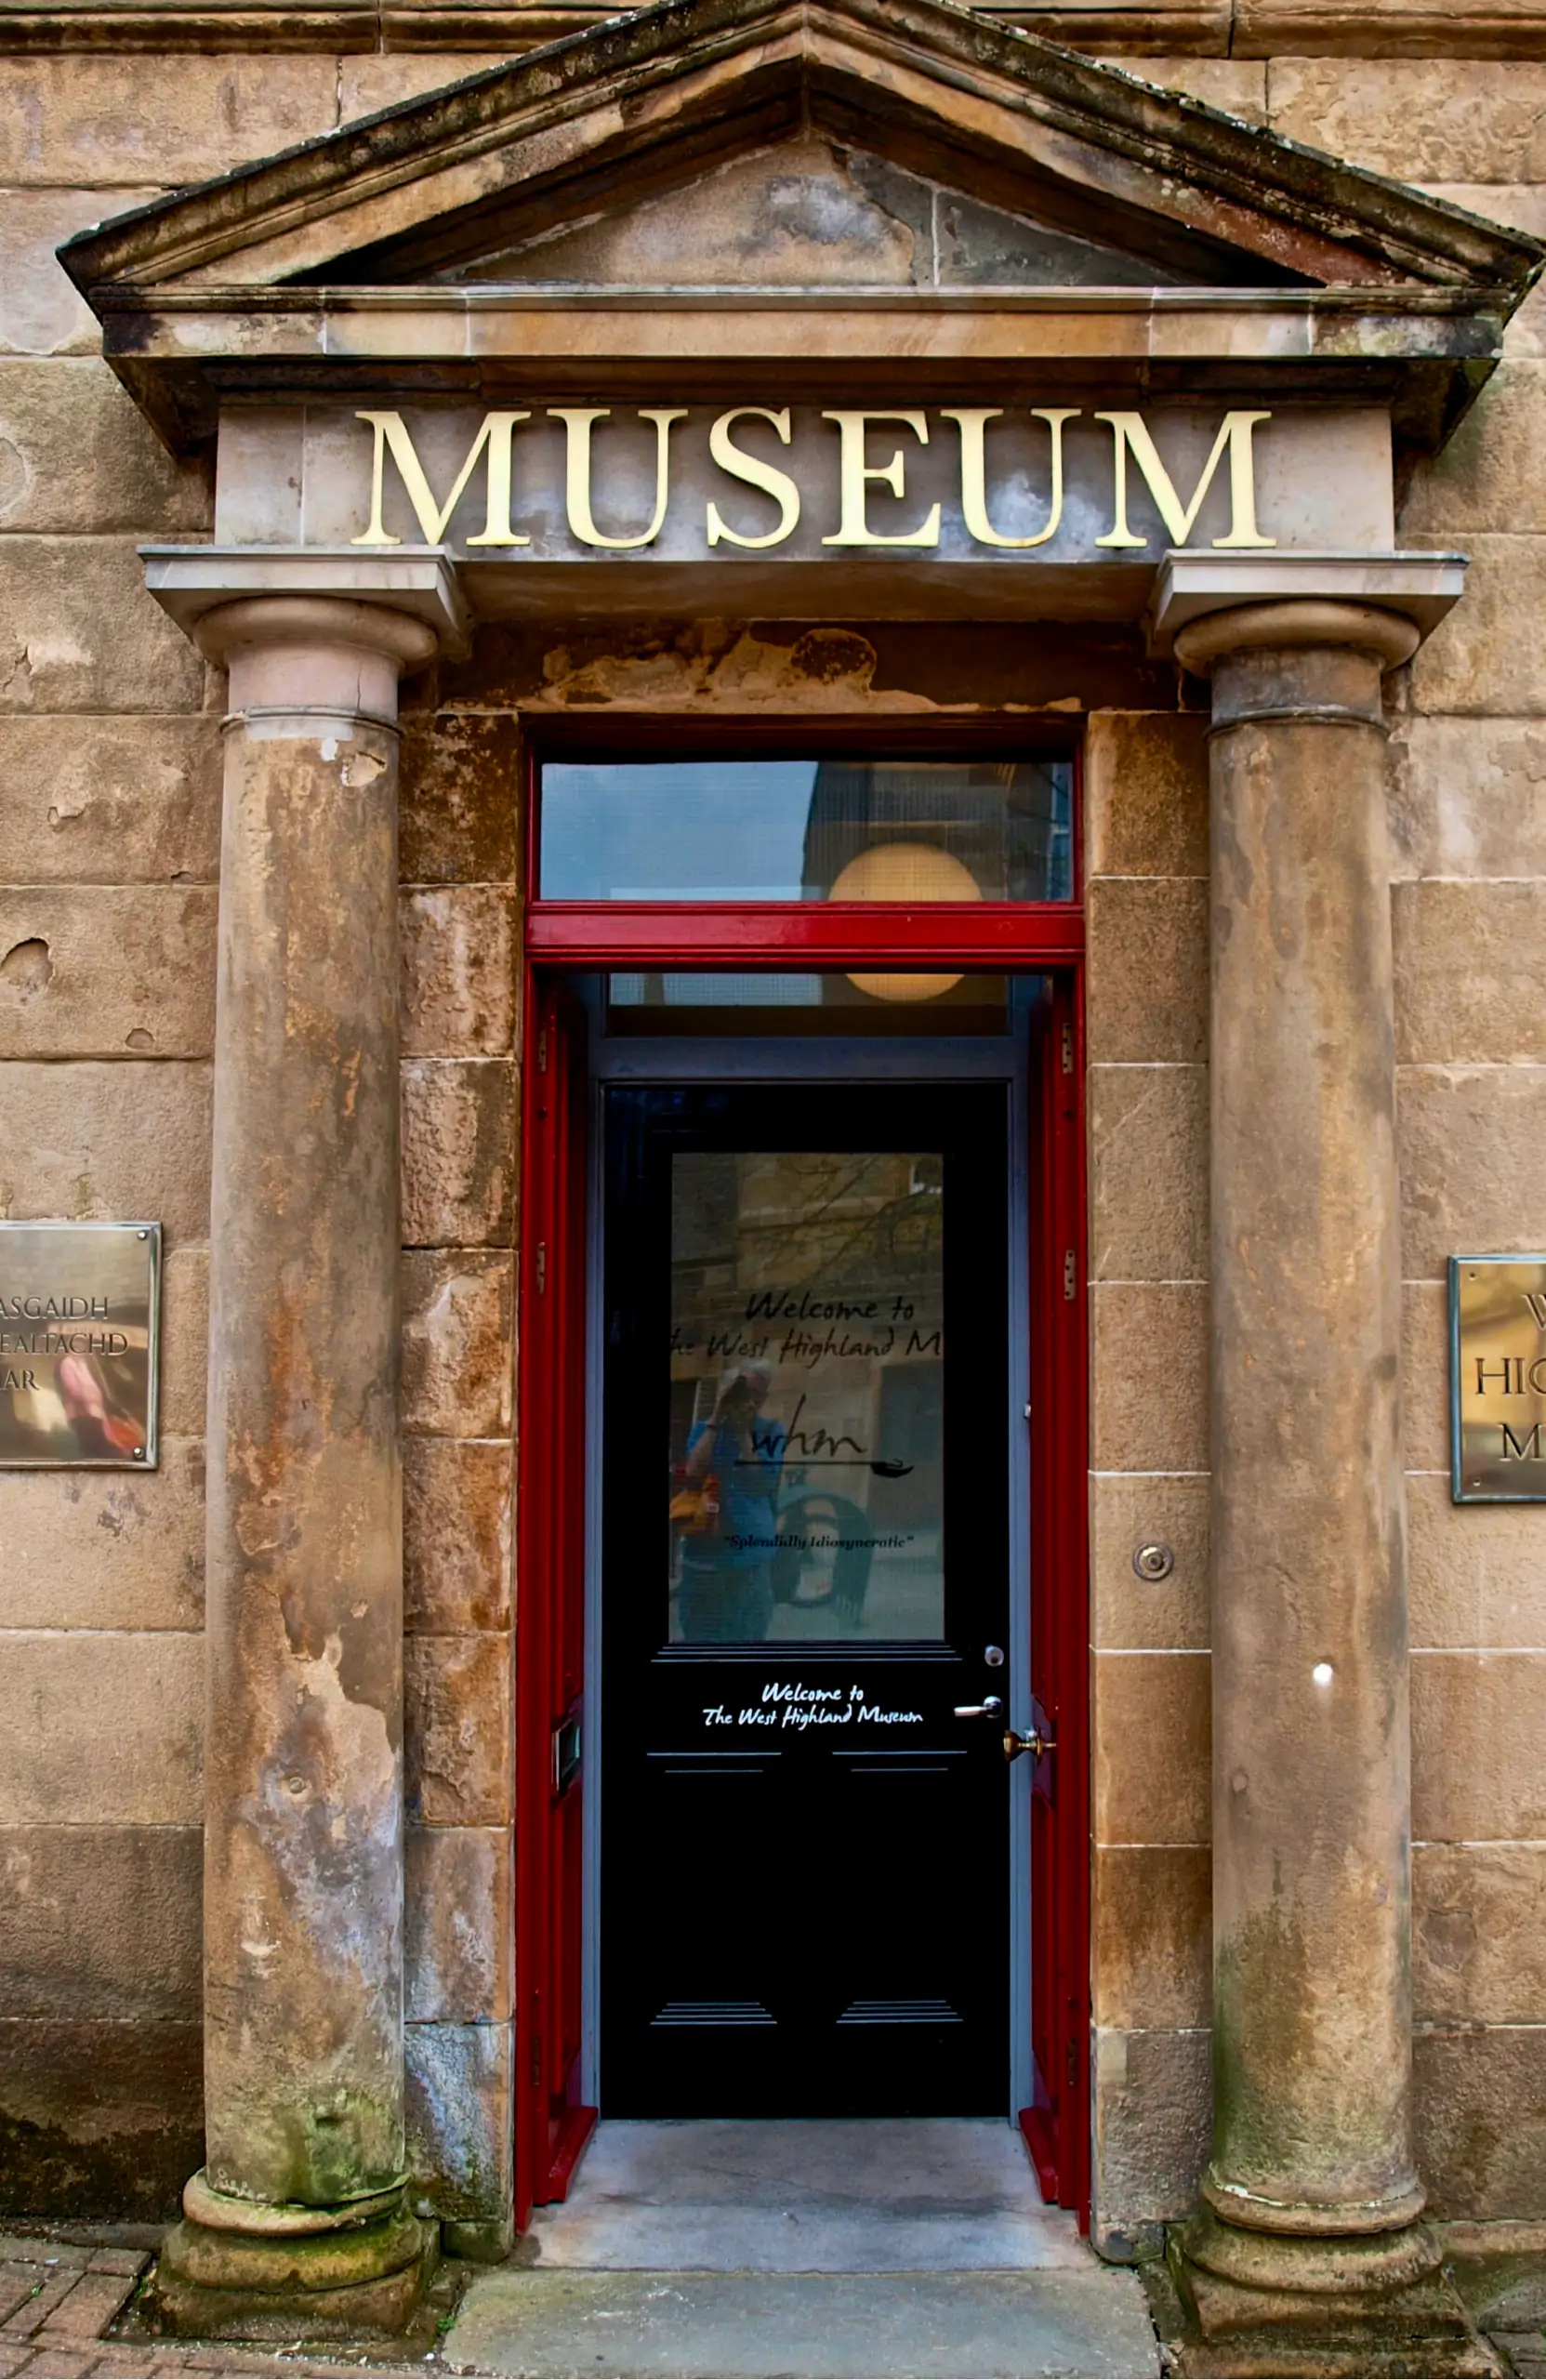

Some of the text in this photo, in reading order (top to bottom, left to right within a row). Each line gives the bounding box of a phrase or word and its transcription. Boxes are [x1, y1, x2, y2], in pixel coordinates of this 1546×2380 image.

[350, 406, 1276, 549] MUSEUM
[746, 1291, 915, 1321] Welcome to
[707, 1329, 768, 1357] West
[779, 1328, 895, 1369] Highland
[0, 1368, 40, 1392] AR
[751, 1394, 869, 1458] whm
[761, 1683, 865, 1703] Welcome to
[703, 1703, 923, 1730] The West Highland Museum
